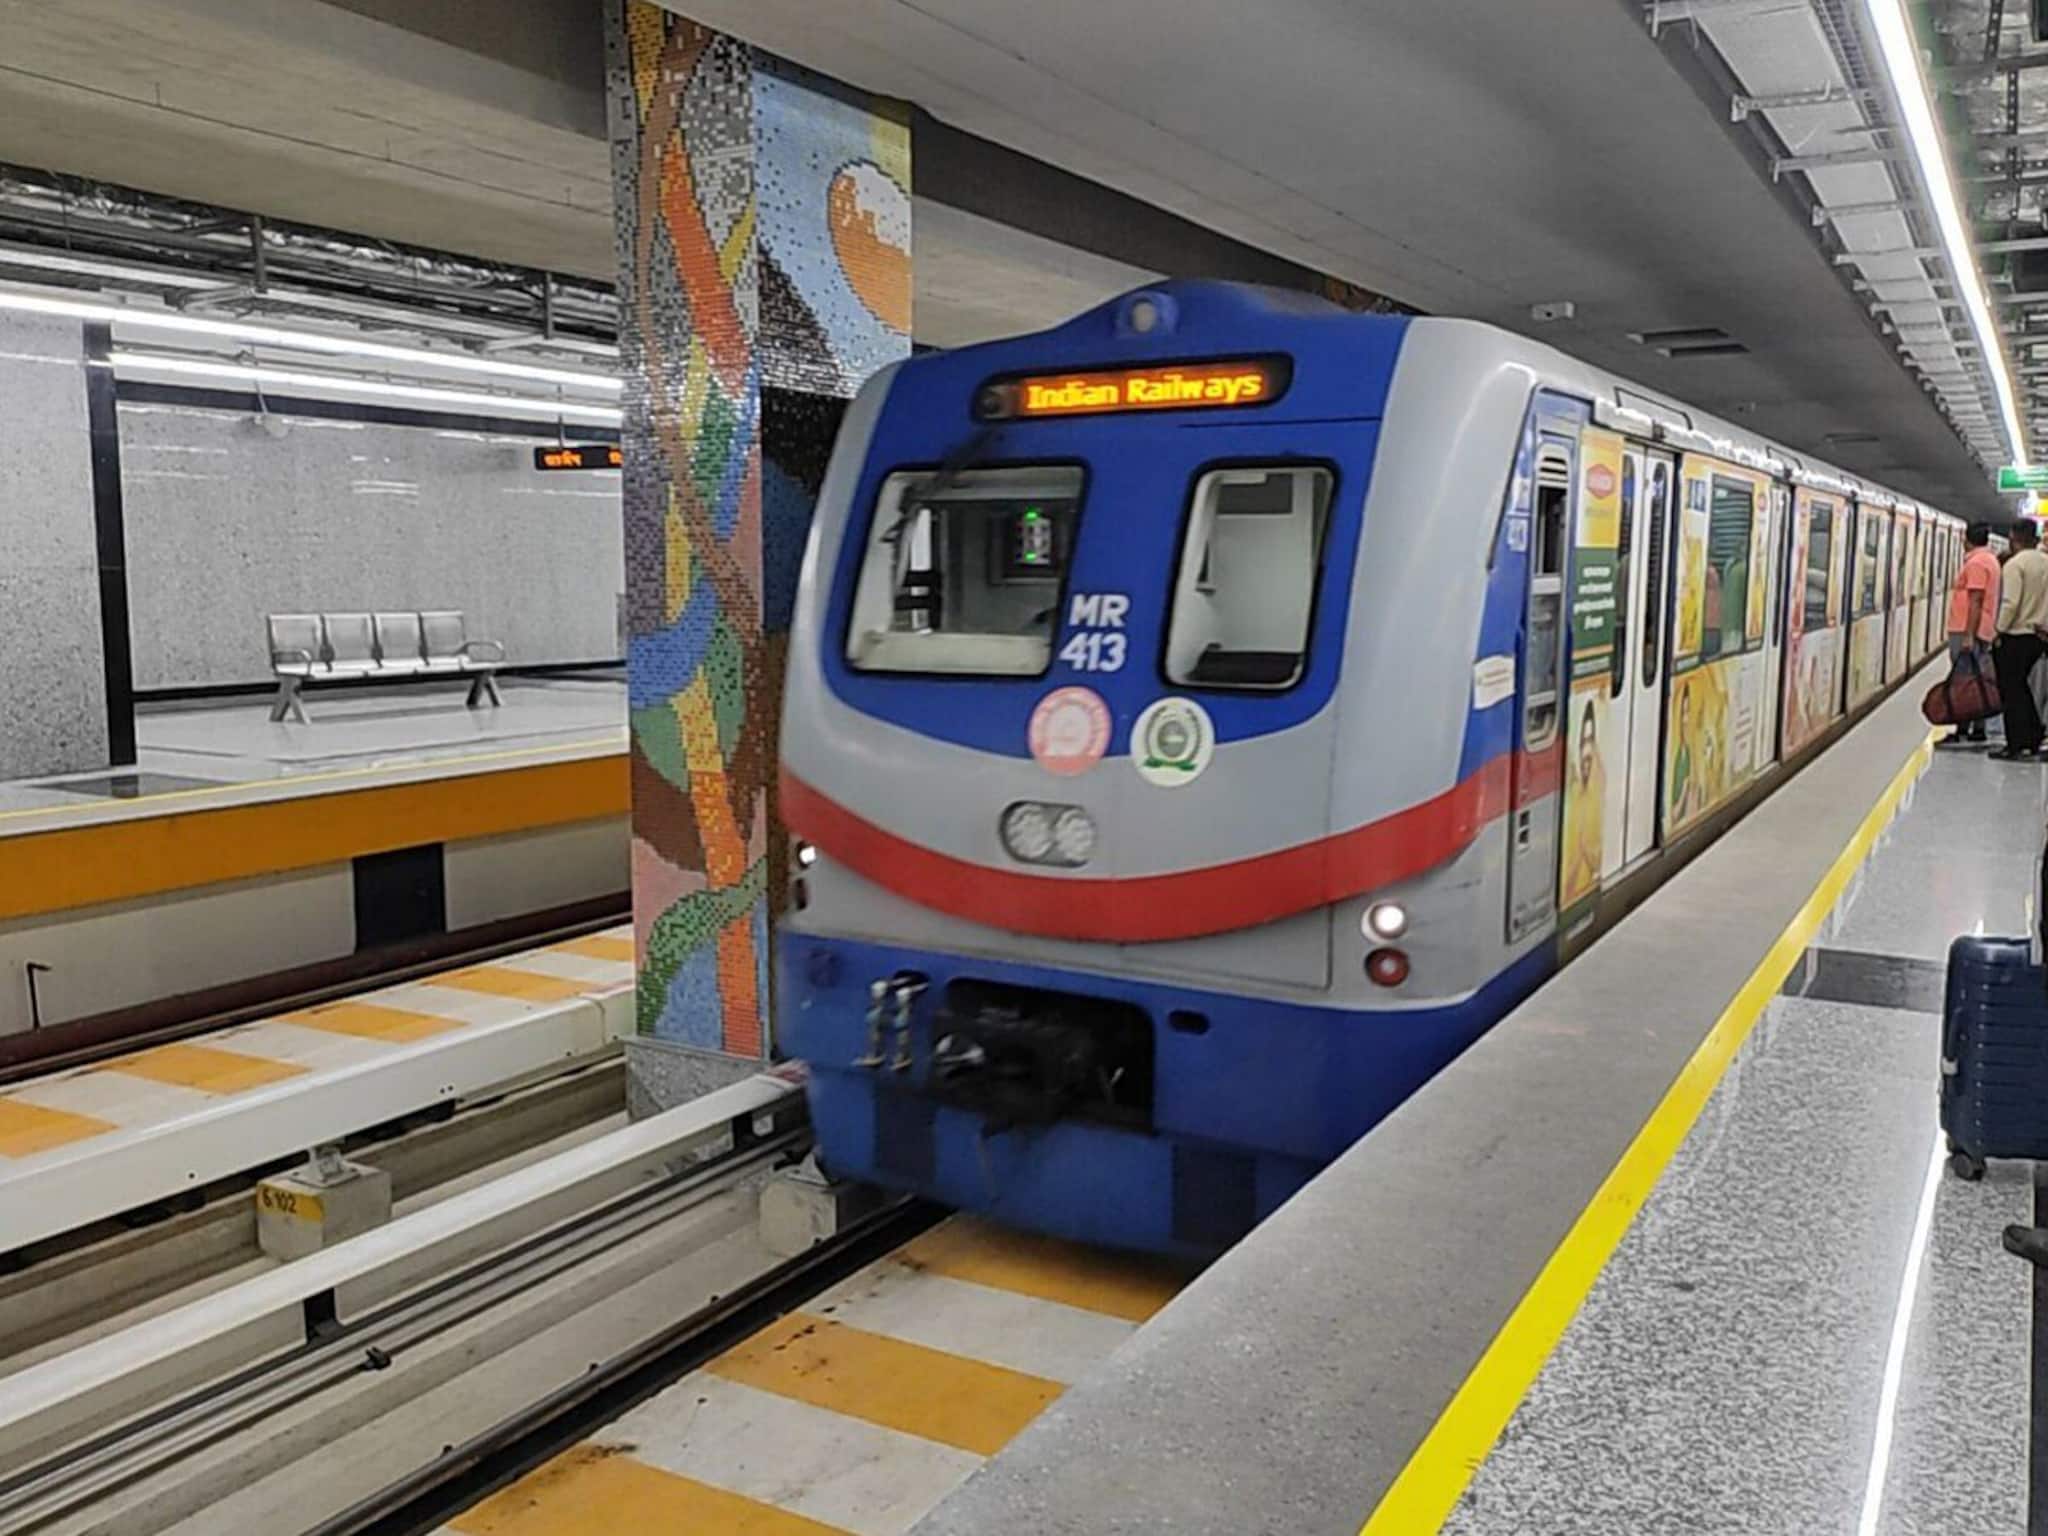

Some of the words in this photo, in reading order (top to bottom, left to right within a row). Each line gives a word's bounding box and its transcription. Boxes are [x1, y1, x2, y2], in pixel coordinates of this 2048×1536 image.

[1027, 381, 1118, 408] Indian
[1127, 374, 1262, 403] Railways
[1069, 594, 1130, 627] MR
[1060, 633, 1127, 672] 413
